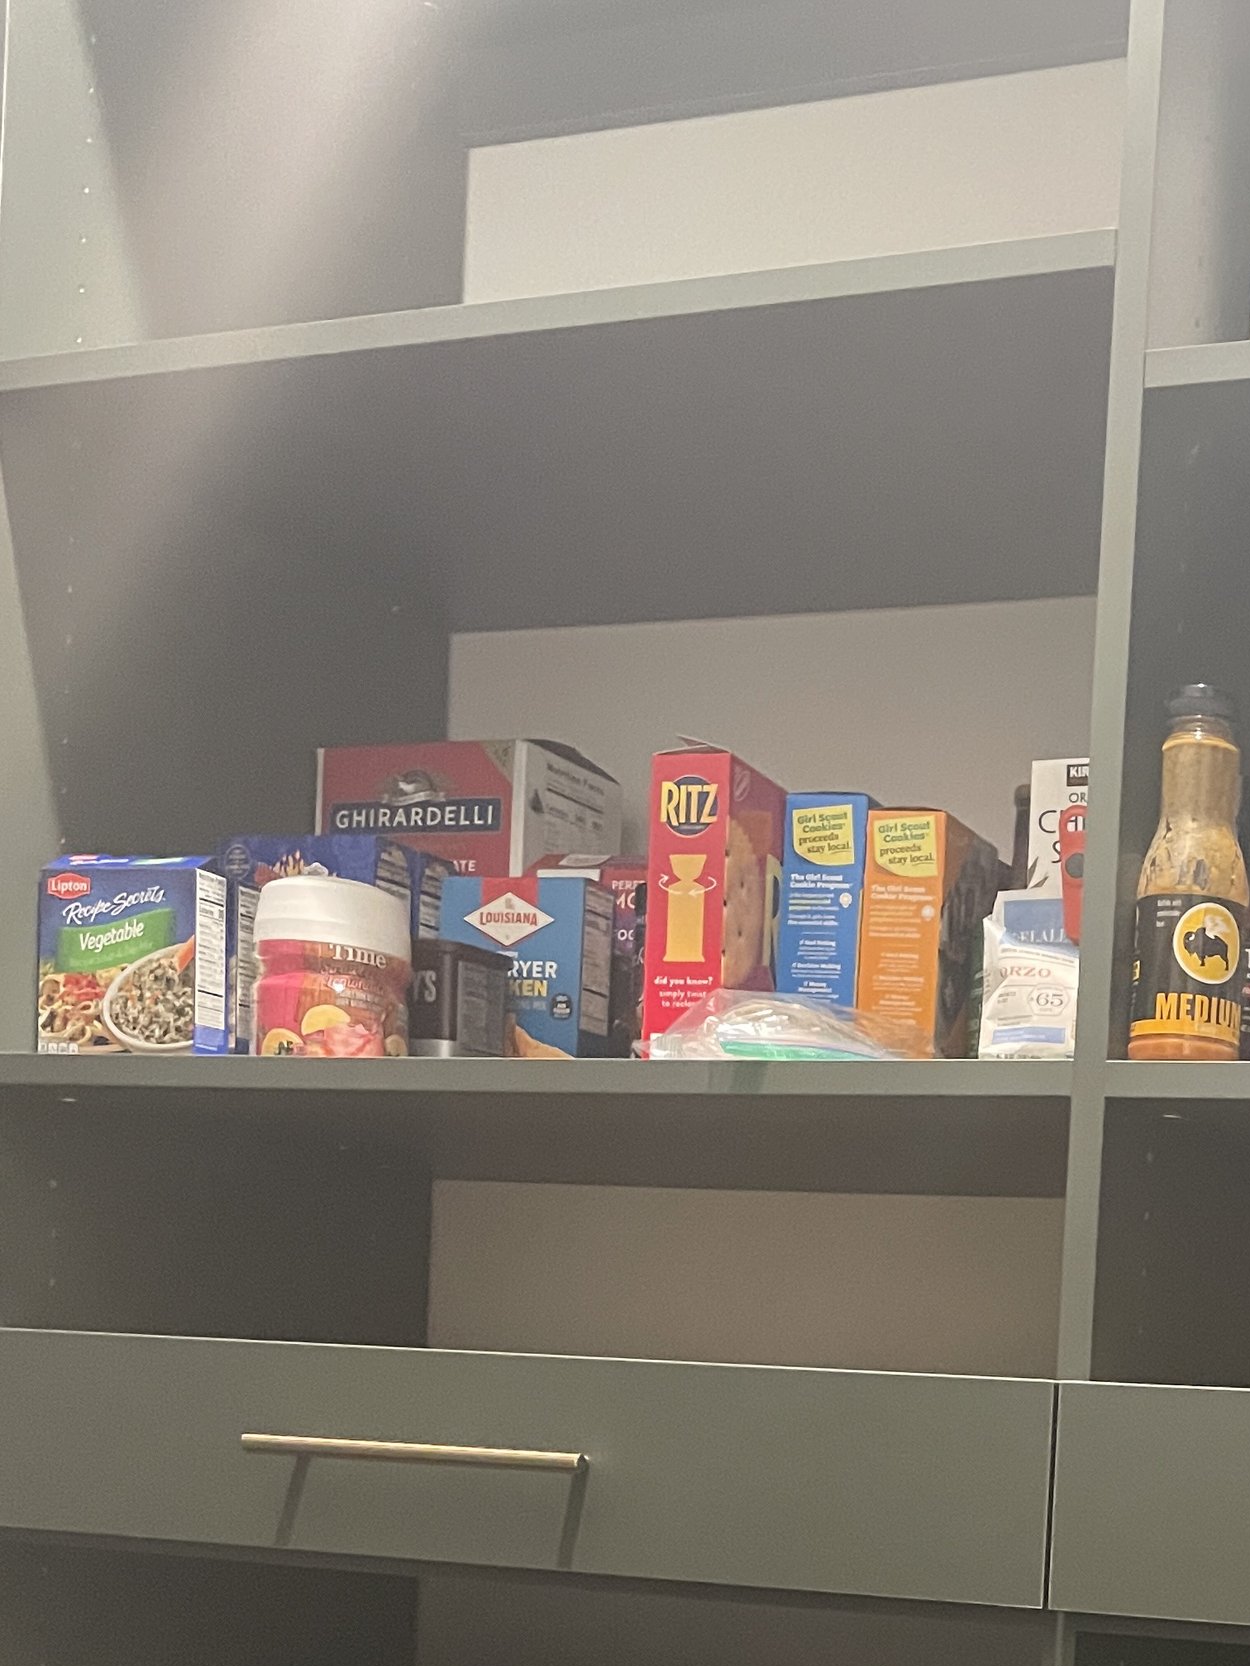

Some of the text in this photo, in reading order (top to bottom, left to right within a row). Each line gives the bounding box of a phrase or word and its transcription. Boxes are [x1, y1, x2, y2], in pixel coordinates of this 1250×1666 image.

[660, 781, 719, 827] RITZ
[335, 805, 494, 829] GHIRARDELLI
[797, 811, 848, 825] Girl Scout
[878, 820, 930, 834] Girl Scout
[879, 843, 922, 857] proceeds
[888, 856, 908, 866] stay
[51, 880, 88, 893] Lipton
[63, 886, 164, 925] Recipe Secrets
[479, 910, 538, 928] LOUISIANA
[79, 919, 145, 953] Vegetable
[654, 976, 668, 986] did
[669, 978, 686, 988] you
[1035, 992, 1064, 1008] 65
